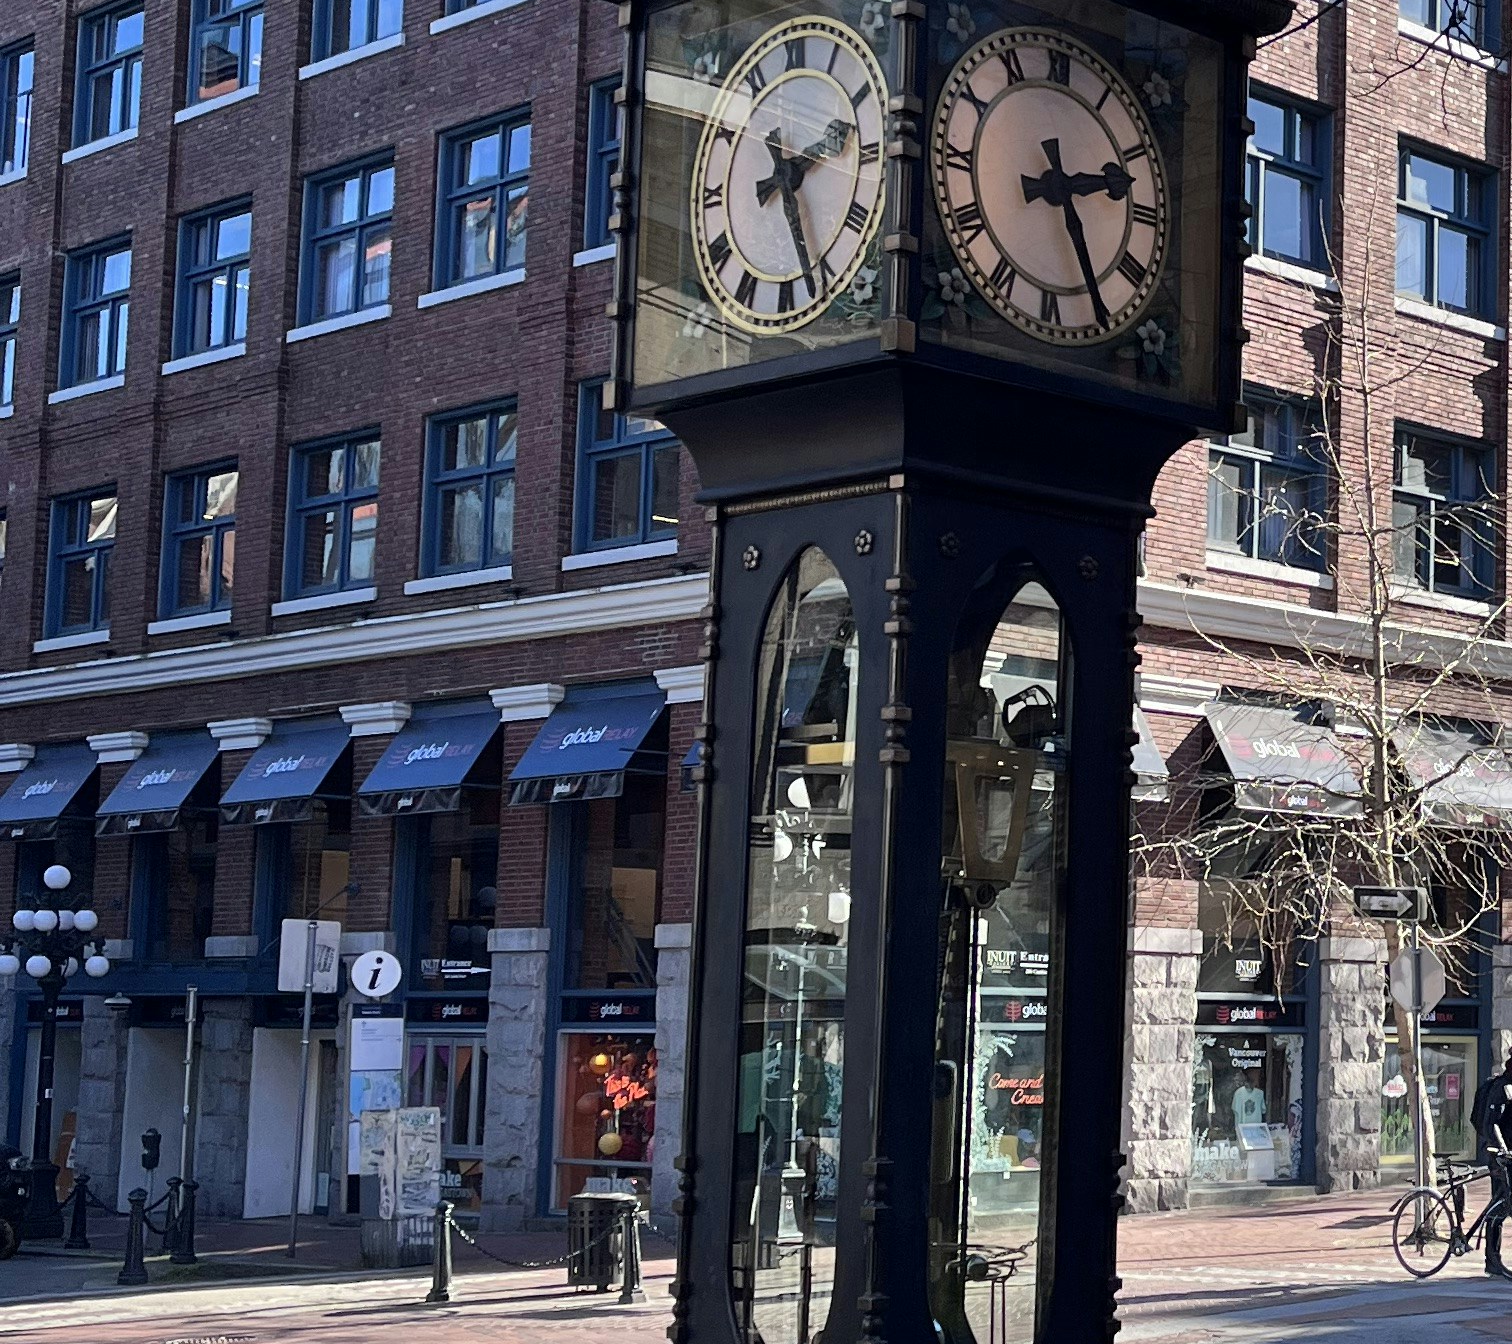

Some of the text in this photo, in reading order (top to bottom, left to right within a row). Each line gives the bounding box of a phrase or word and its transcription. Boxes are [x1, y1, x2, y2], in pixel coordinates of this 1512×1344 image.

[999, 50, 1025, 86] XI
[947, 143, 972, 172] IX
[1133, 203, 1157, 227] III
[559, 725, 608, 749] global
[404, 742, 448, 765] global
[1253, 737, 1300, 758] global
[263, 755, 305, 778] global
[137, 769, 176, 789] global
[1287, 796, 1307, 808] global
[1020, 951, 1049, 962] Entra
[442, 1004, 462, 1018] global
[600, 1003, 622, 1018] global
[1022, 1003, 1048, 1019] globa
[1230, 1006, 1257, 1022] global
[1228, 1047, 1267, 1057] Vancouver
[1231, 1058, 1262, 1069] Original
[989, 1072, 1045, 1089] Come and
[1011, 1088, 1044, 1105] Crea
[1194, 1142, 1239, 1161] make
[440, 1170, 462, 1186] ake
